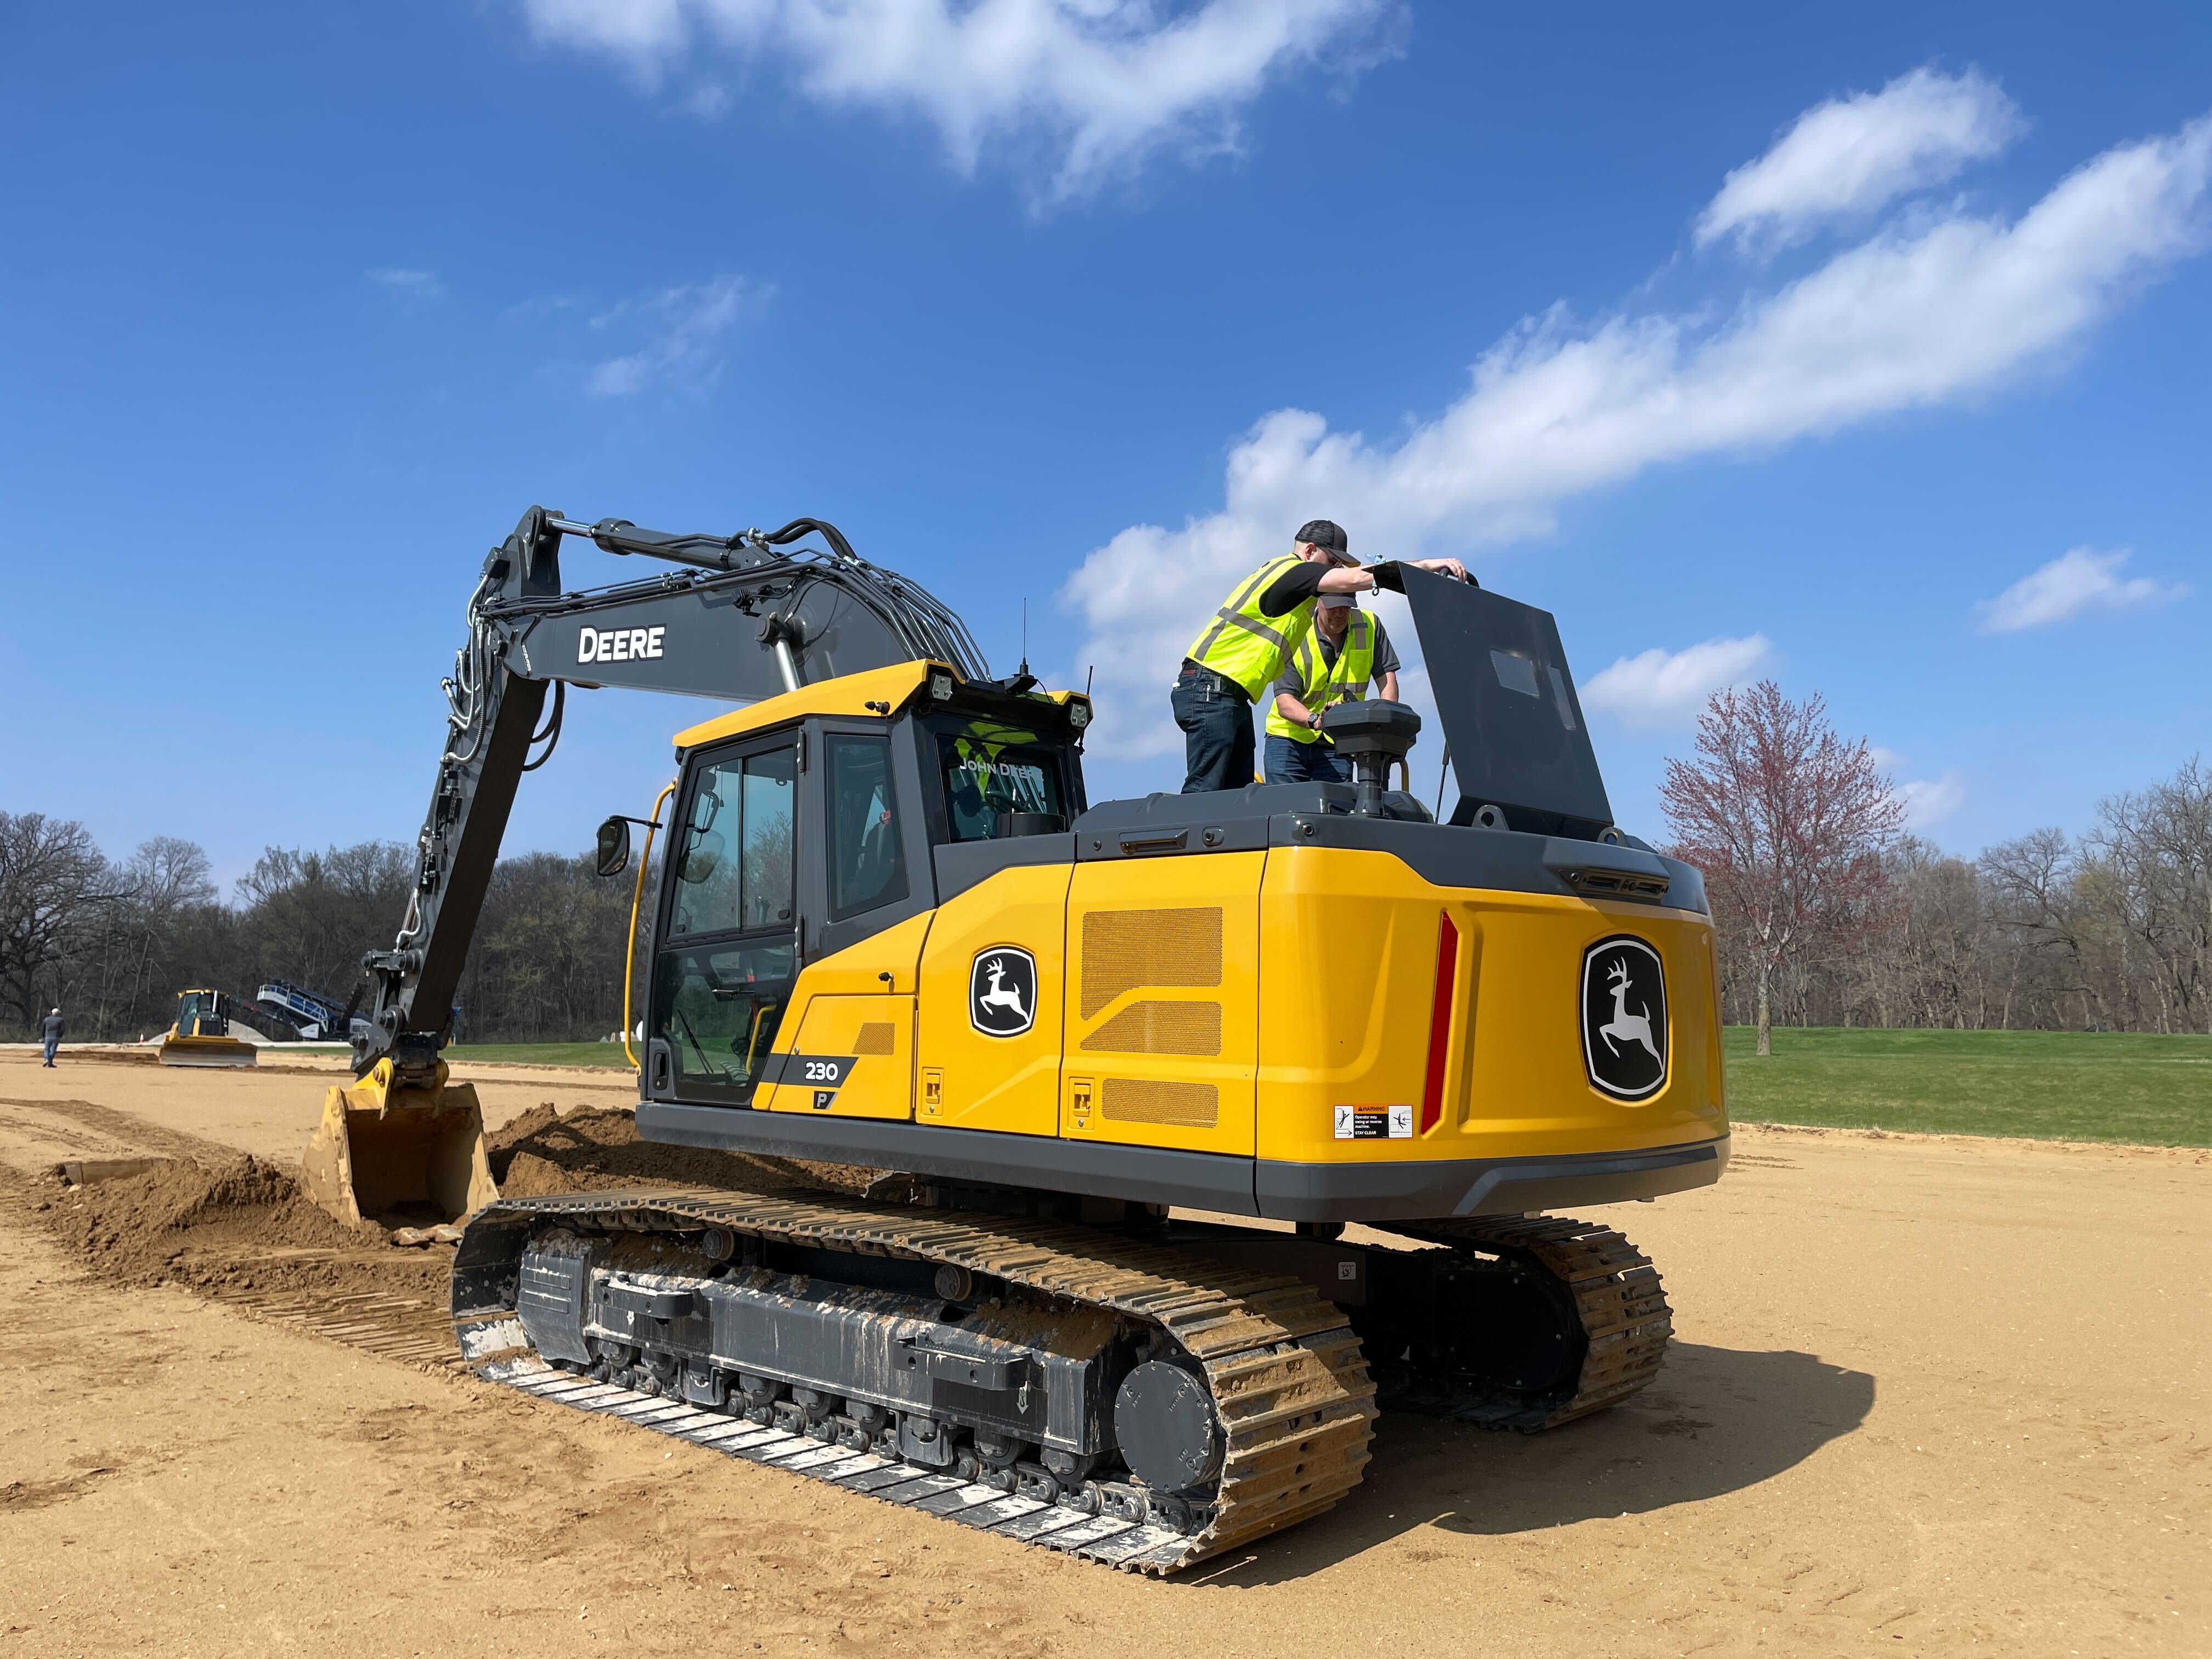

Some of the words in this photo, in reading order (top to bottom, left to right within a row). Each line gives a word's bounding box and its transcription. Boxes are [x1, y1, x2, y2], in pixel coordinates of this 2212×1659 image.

[578, 627, 665, 663] DEERE
[960, 757, 997, 775] JOHN
[805, 1062, 838, 1081] 230
[816, 1093, 827, 1108] P
